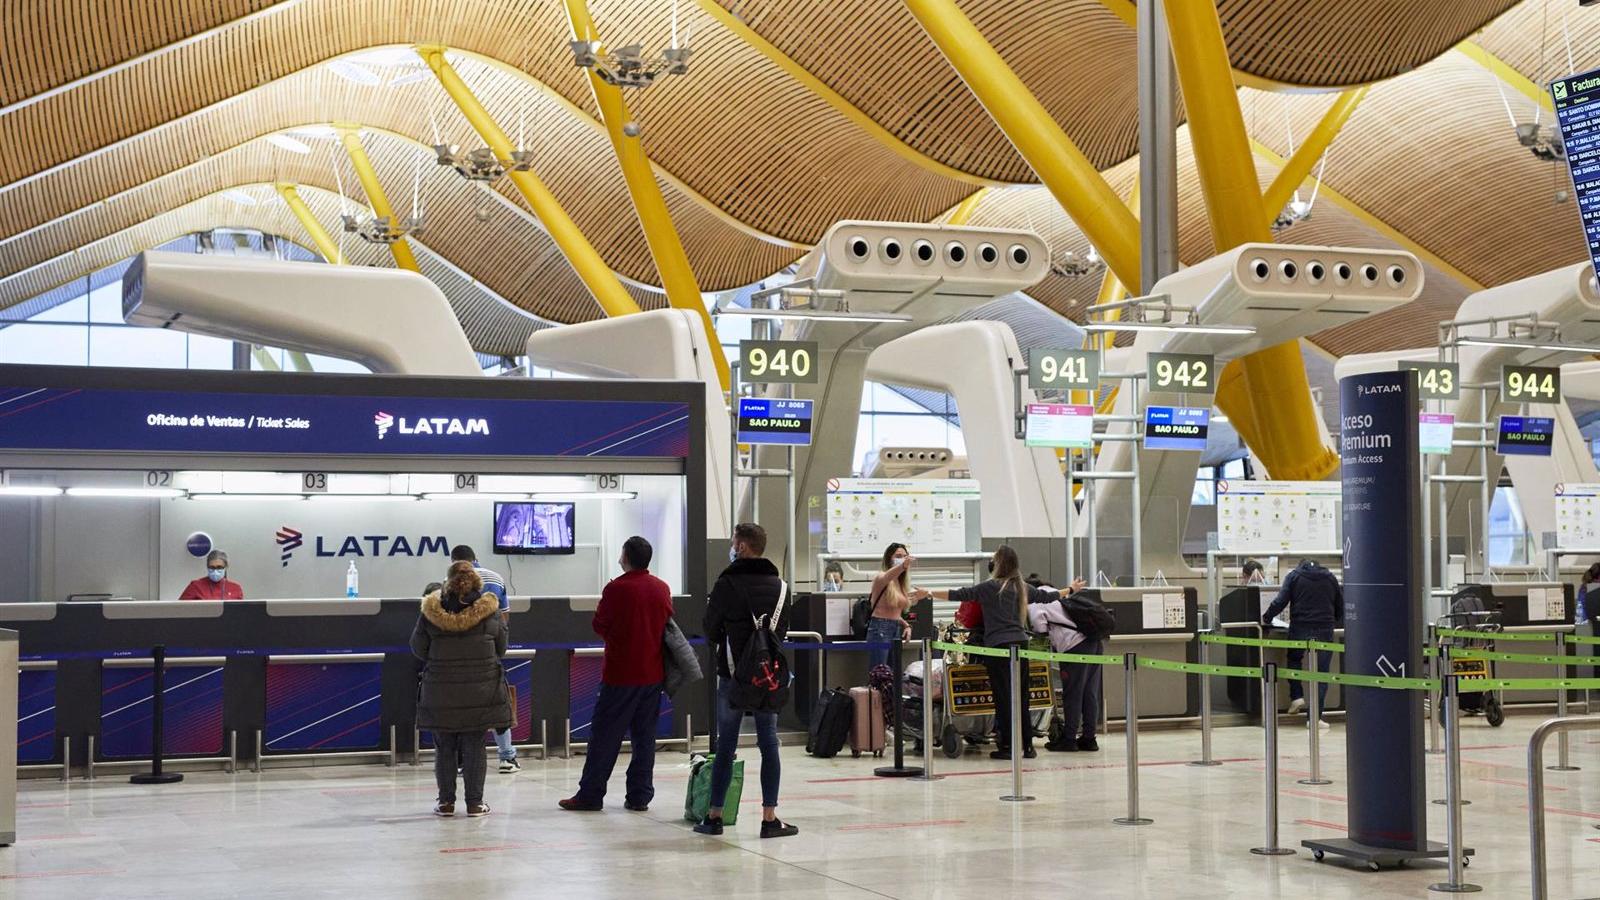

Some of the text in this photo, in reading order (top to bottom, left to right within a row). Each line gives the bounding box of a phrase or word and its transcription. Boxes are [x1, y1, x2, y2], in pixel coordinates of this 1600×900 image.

[749, 348, 810, 376] 940
[1041, 356, 1088, 383] 941
[1156, 360, 1207, 387] 942
[1365, 385, 1401, 394] LATAM
[1508, 372, 1555, 398] 944
[147, 414, 188, 426] Oficina
[190, 414, 204, 426] de
[206, 415, 245, 427] Ventas
[256, 417, 283, 428] Ticket
[285, 417, 310, 428] Sales
[399, 418, 490, 435] LATAM
[1172, 426, 1199, 434] PAULO
[1358, 455, 1383, 464] Access
[147, 472, 169, 487] 02
[305, 473, 325, 488] 03
[456, 474, 476, 489] 04
[599, 474, 618, 489] 05
[316, 536, 450, 557] LATAM
